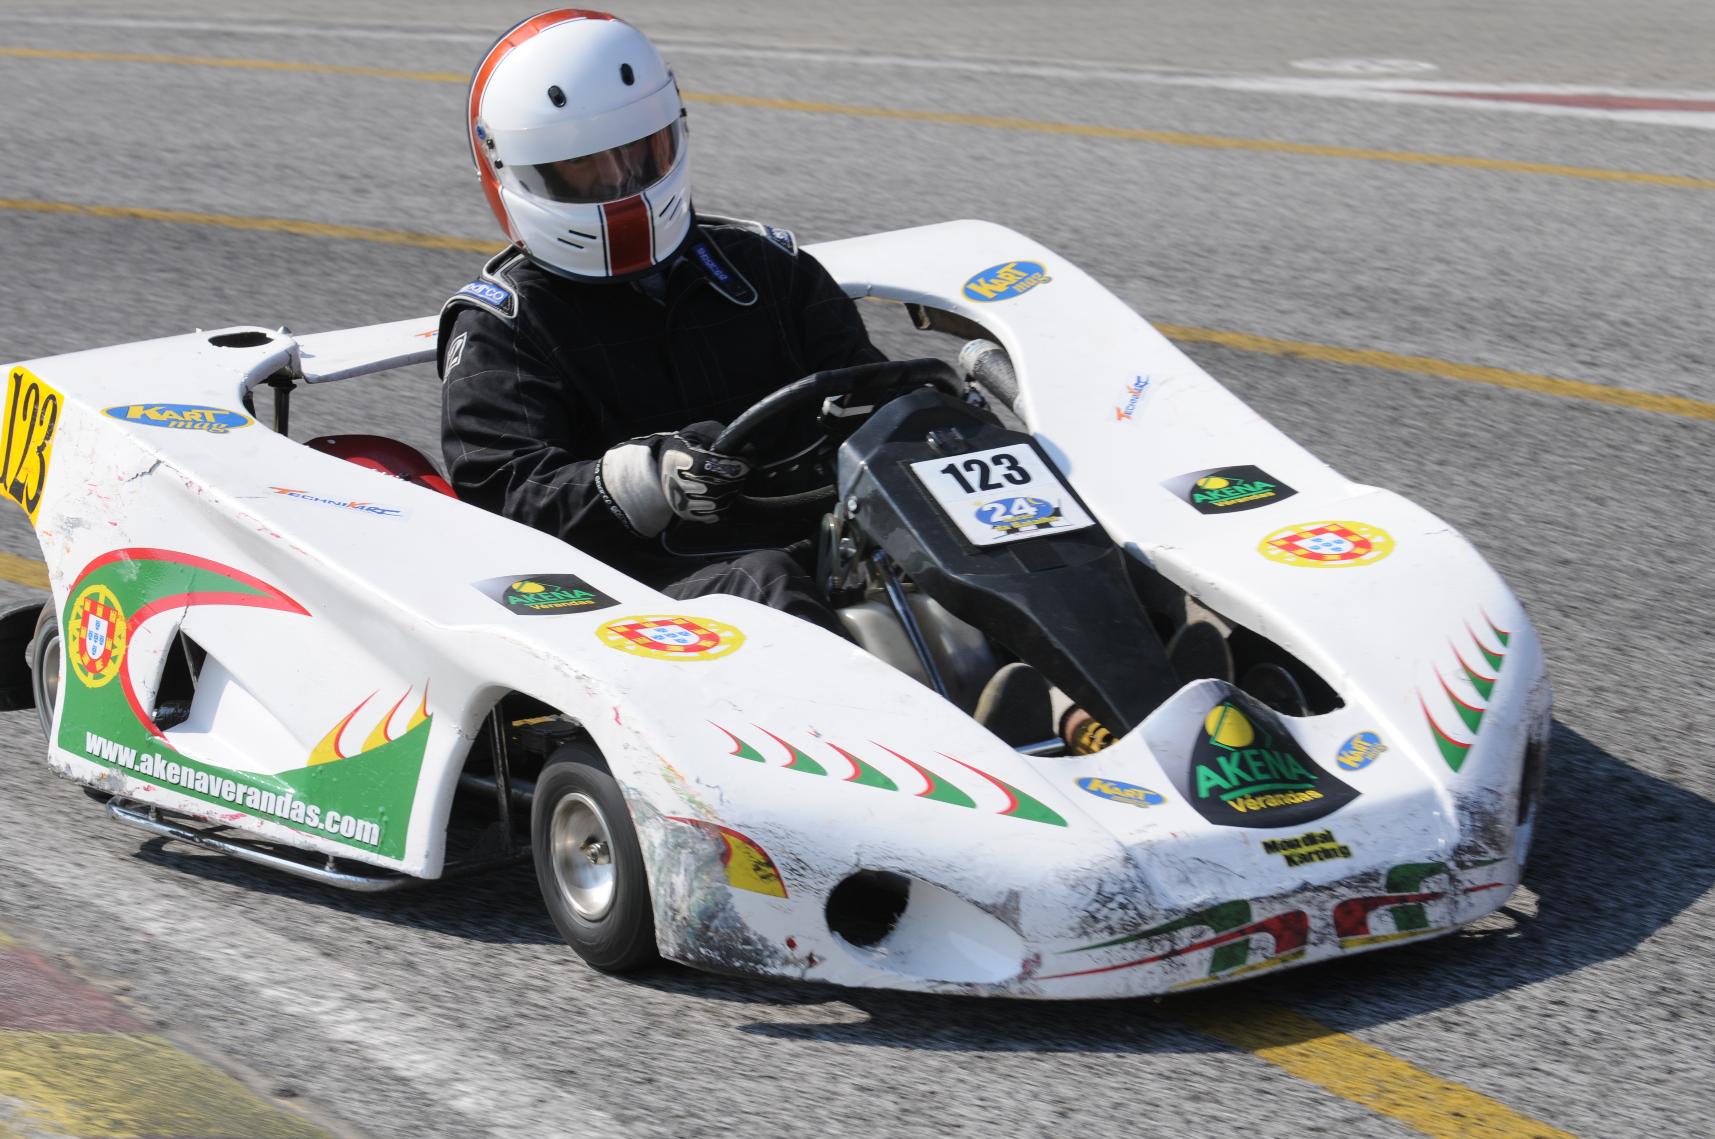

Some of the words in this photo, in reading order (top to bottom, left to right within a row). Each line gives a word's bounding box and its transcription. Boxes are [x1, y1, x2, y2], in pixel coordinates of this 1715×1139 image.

[126, 405, 231, 423] KART
[0, 372, 58, 514] 123
[940, 453, 1032, 495] 123
[1192, 481, 1277, 503] AKENA
[981, 498, 1039, 523] 24
[507, 589, 597, 605] AKENA
[85, 731, 381, 847] www.akenaverandas.com
[1196, 749, 1319, 799] AKENA
